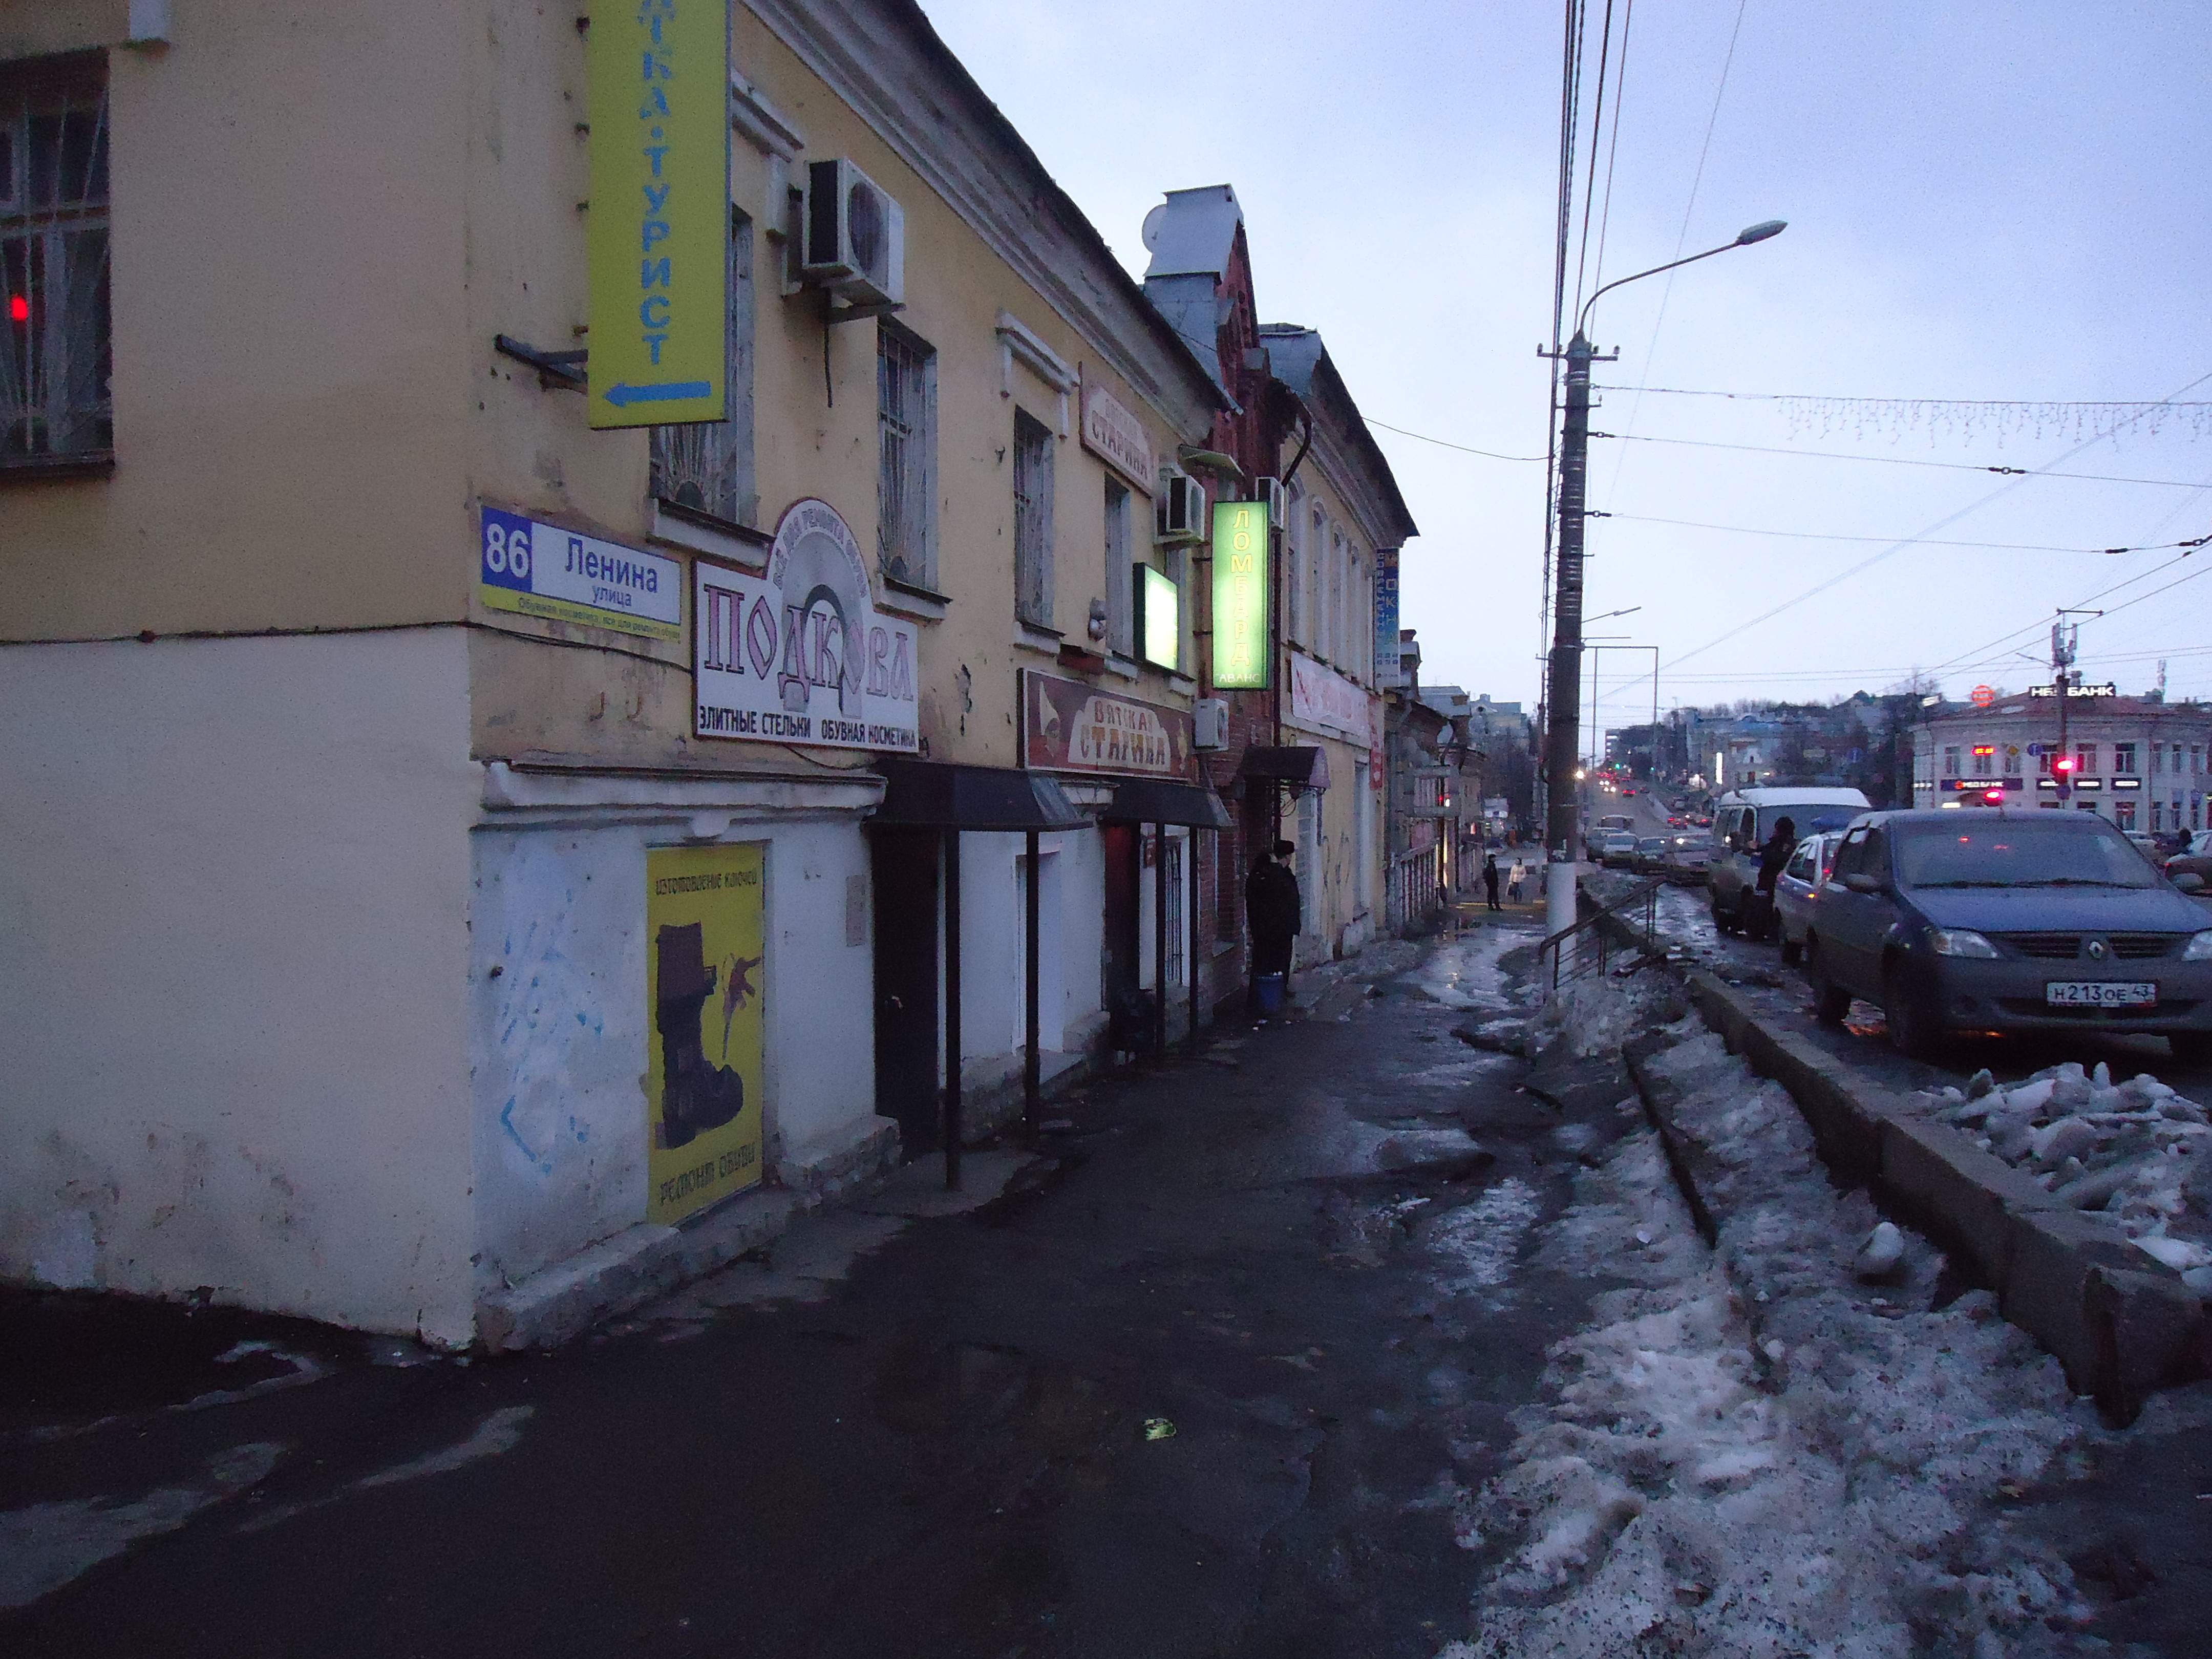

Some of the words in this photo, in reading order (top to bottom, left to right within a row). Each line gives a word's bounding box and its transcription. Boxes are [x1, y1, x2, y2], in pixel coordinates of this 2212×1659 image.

[639, 146, 671, 366] ТУРИСТ
[486, 523, 529, 578] 86
[565, 537, 658, 593] Ленина
[592, 585, 632, 607] улица
[1230, 509, 1252, 666] ЛОМБАРД
[704, 583, 914, 703] ПОДКОВА
[2067, 686, 2114, 696] БАНК
[699, 706, 757, 733] ЭЛИТНЫЕ
[762, 712, 811, 738] СТЕЛЬКИ
[821, 719, 866, 743] ОБУВНАЯ
[868, 724, 917, 748] КОСМЕТИКА
[1080, 724, 1165, 765] СТАРИНА
[2054, 985, 2126, 1001] Н213ОЕ
[720, 1142, 755, 1178] ОБУВИ
